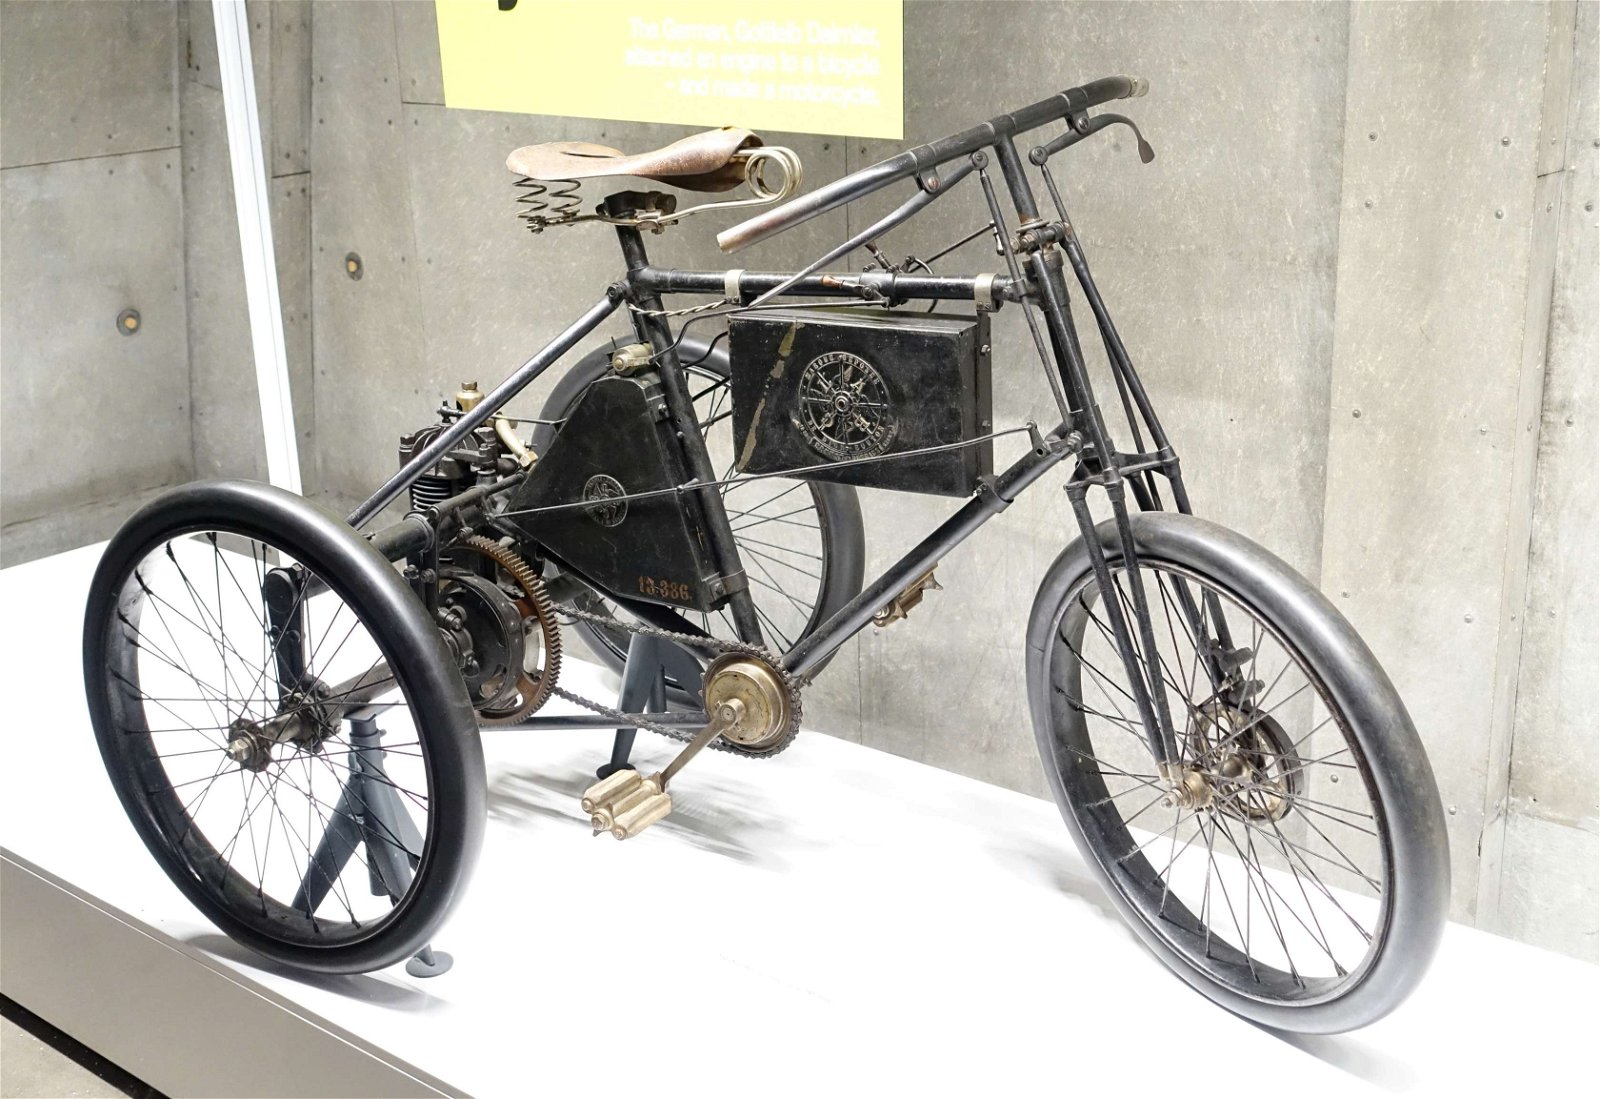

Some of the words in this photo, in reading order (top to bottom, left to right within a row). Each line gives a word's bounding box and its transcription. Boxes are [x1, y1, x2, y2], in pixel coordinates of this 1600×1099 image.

[629, 16, 659, 40] The
[662, 17, 733, 45] German,
[735, 18, 802, 44] Gottlieb
[626, 46, 692, 68] attached
[696, 53, 717, 68] an
[720, 53, 776, 79] engine
[780, 51, 801, 73] to
[803, 55, 814, 73] a
[818, 51, 881, 80] bicycle
[679, 74, 710, 97] and
[713, 78, 760, 98] made
[764, 83, 775, 99] a
